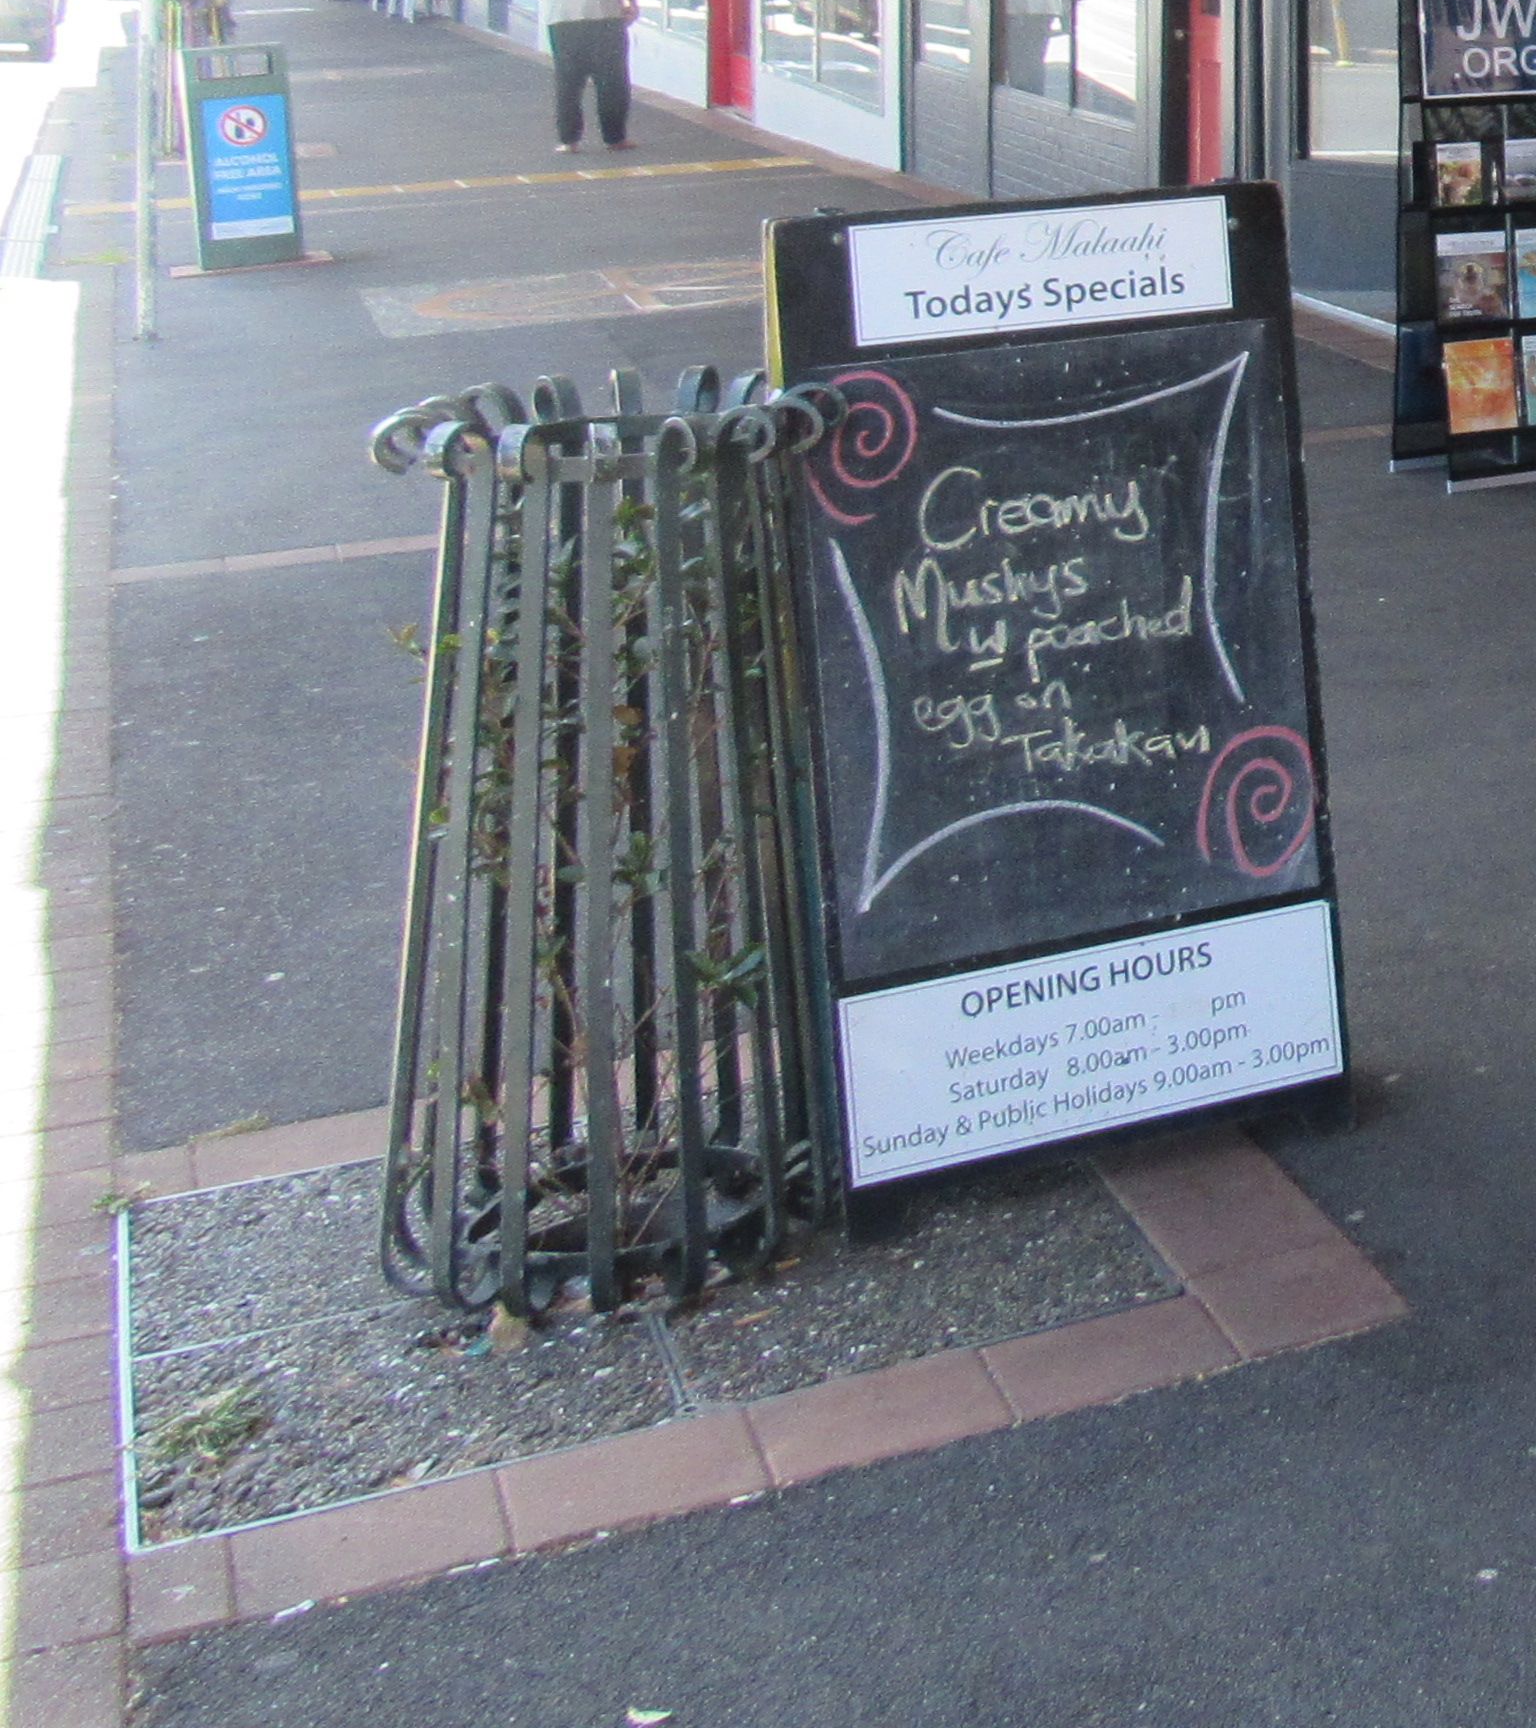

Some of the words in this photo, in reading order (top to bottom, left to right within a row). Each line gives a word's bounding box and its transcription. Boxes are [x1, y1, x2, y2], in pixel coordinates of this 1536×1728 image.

[926, 229, 1011, 279] Cafe
[1020, 219, 1168, 262] Malaahi
[905, 283, 1032, 320] Todays
[1044, 266, 1186, 313] Specials
[919, 467, 1149, 551] Creamy
[1028, 575, 1194, 683] poached
[913, 693, 1000, 749] egg
[1014, 680, 1073, 709] on
[960, 965, 1101, 1019] OPENING
[1109, 942, 1214, 986] HOURS
[946, 1029, 1060, 1071] Weekdays
[1065, 1012, 1147, 1044] 7.00am
[1210, 990, 1247, 1016] pm
[949, 1066, 1050, 1104] Saturday
[1066, 1046, 1149, 1078] 8.00am
[1167, 1022, 1249, 1058] 3.00pm
[863, 1122, 949, 1159] Sunday
[956, 1115, 972, 1137] &
[978, 1099, 1047, 1132] Public
[1053, 1075, 1150, 1113] Holidays
[1154, 1057, 1233, 1091] 9.00am
[1252, 1035, 1331, 1069] 3.00pm
